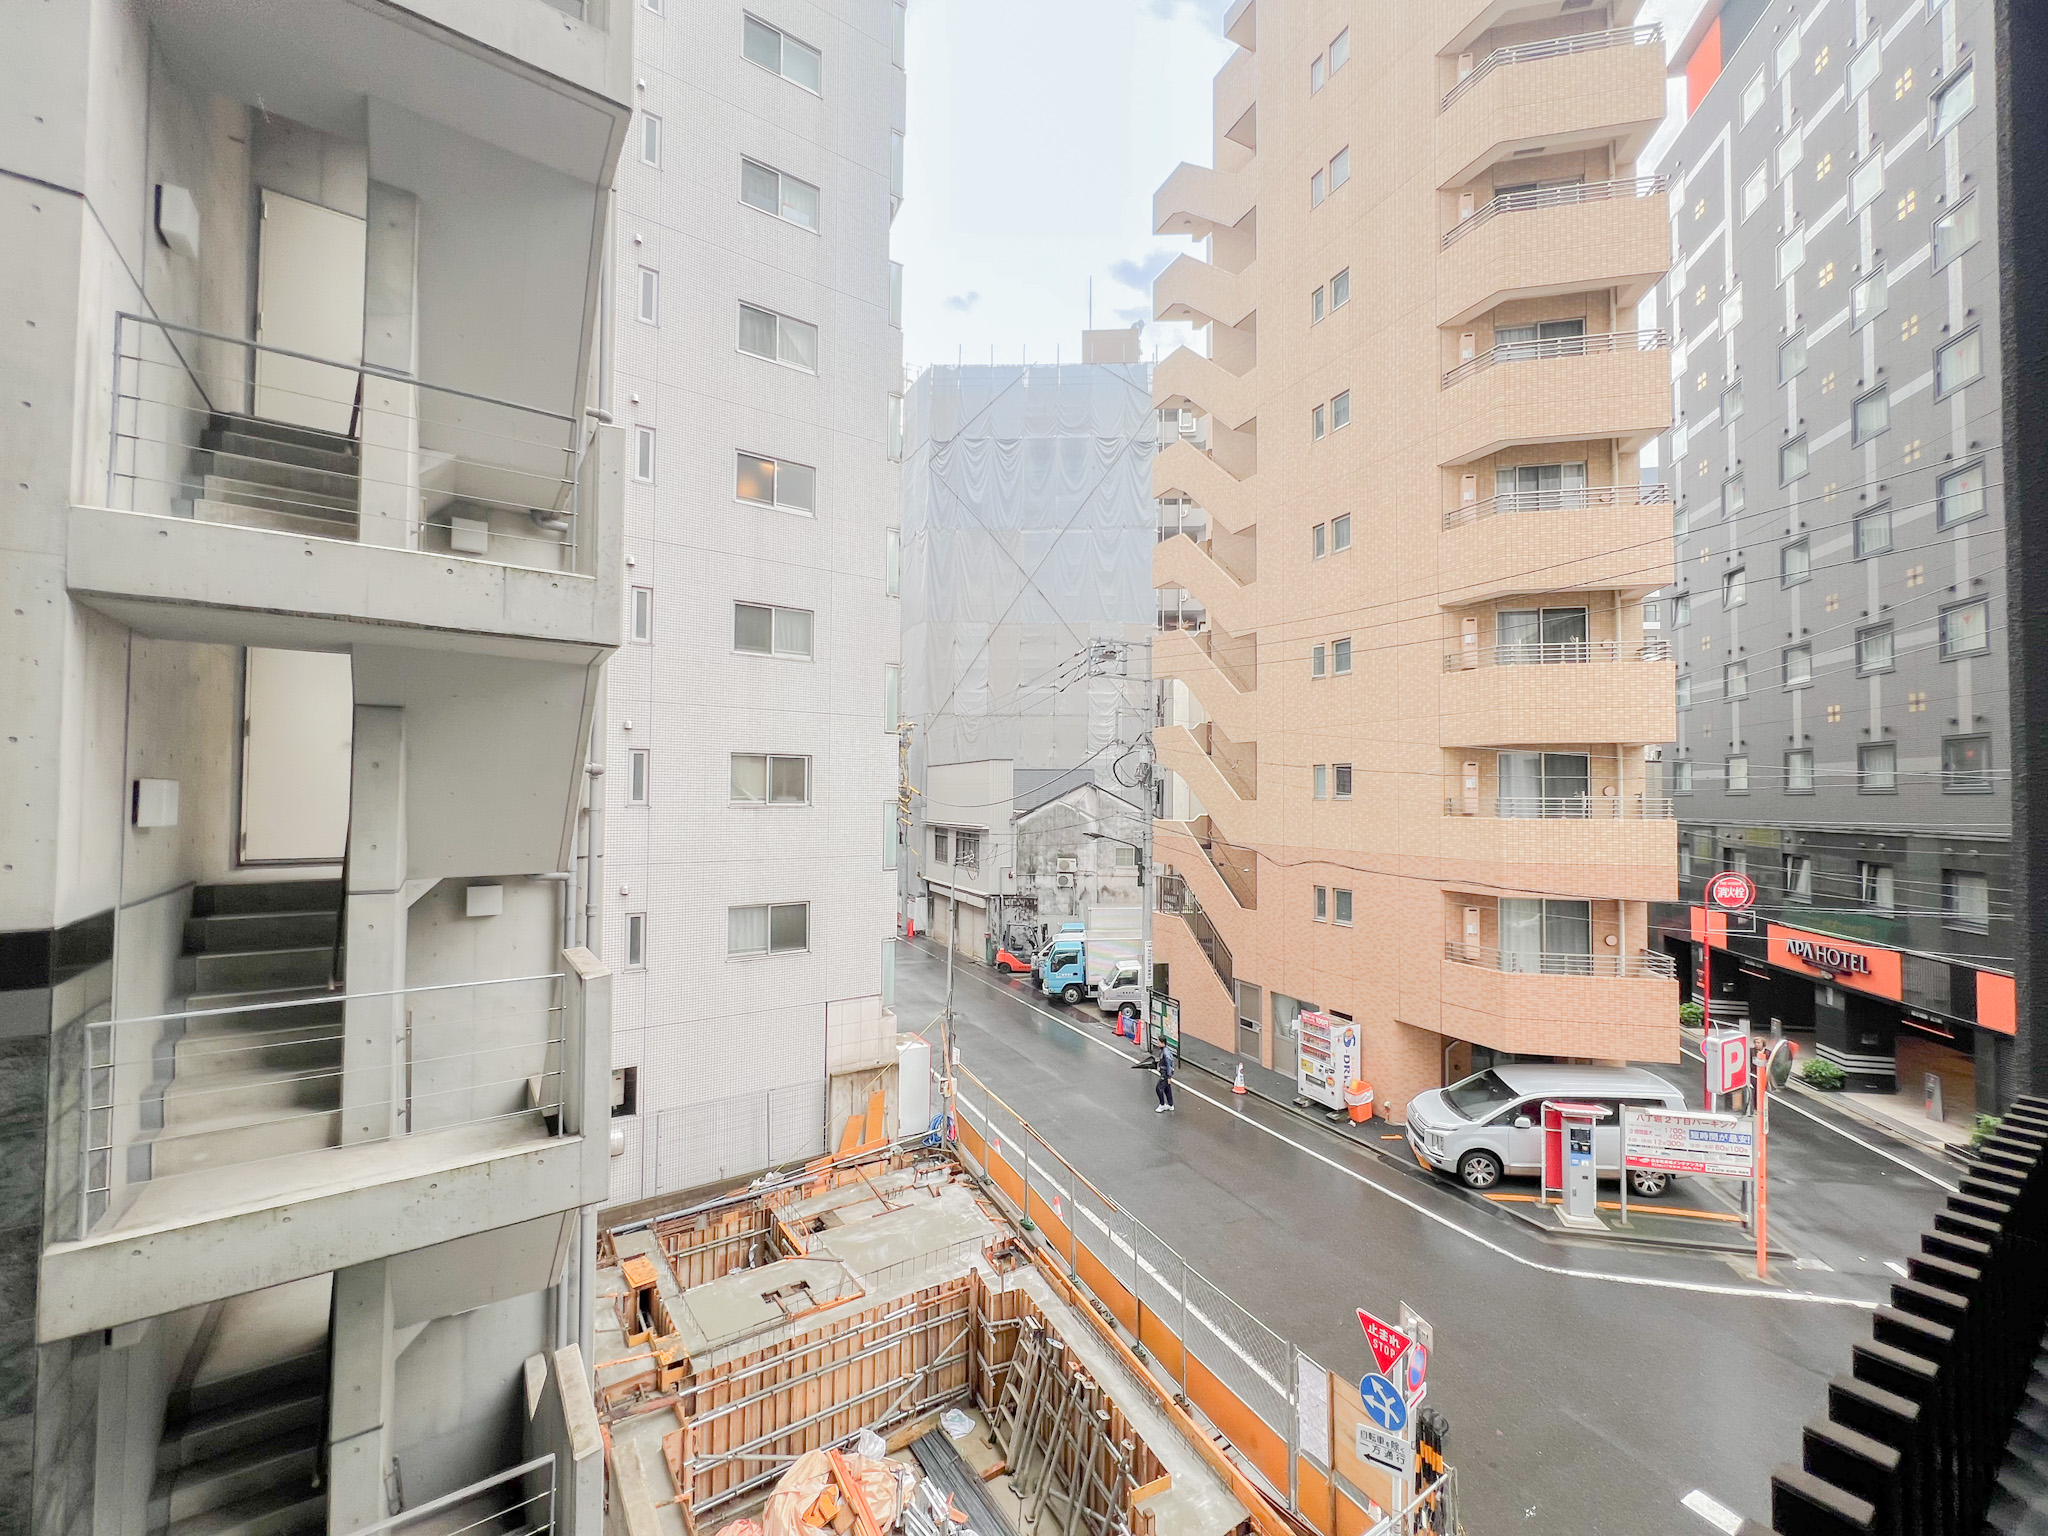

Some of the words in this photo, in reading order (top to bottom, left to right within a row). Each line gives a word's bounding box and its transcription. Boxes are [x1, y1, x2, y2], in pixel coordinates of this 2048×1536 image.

[1717, 886, 1745, 898] 消火栓
[1786, 939, 1814, 960] APA
[1816, 945, 1869, 975] HOTEL
[1724, 1041, 1745, 1089] P
[1367, 1322, 1401, 1349] 止まれ
[1372, 1338, 1396, 1359] STOP
[1359, 1441, 1406, 1465] 一方通行
[1360, 1429, 1405, 1454] 自転車を除く
